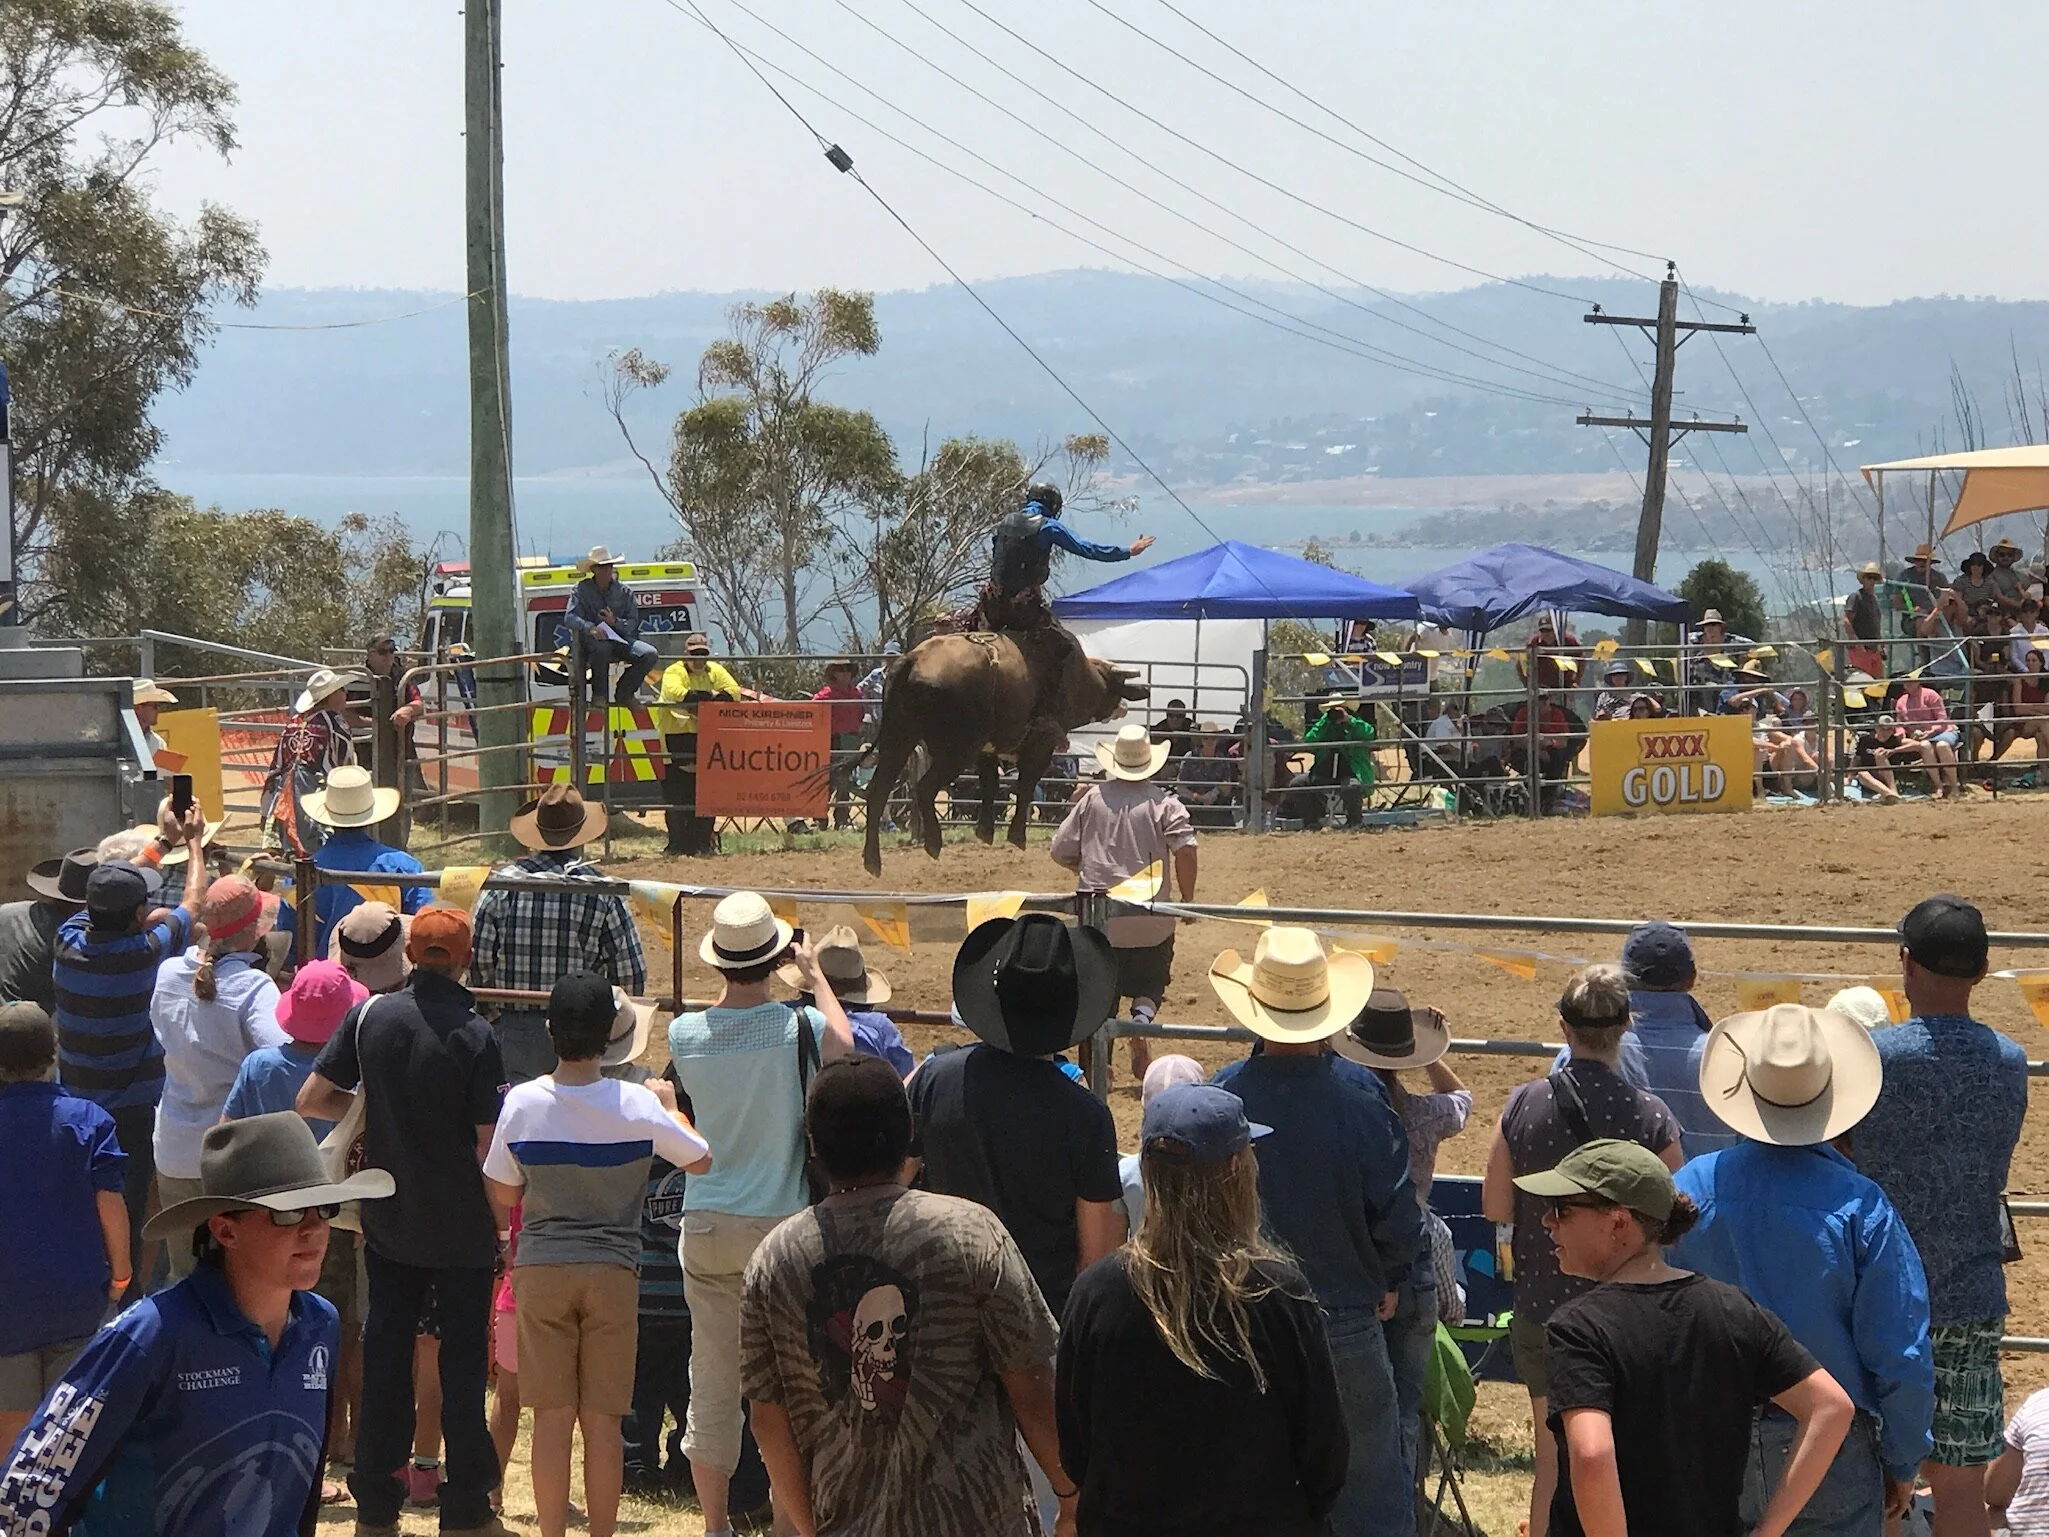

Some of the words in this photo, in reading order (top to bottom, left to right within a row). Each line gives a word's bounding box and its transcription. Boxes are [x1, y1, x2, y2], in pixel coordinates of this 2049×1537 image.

[669, 611, 687, 622] 12
[719, 709, 748, 718] NICK
[752, 710, 814, 719] KIRSHNER
[1645, 735, 1704, 758] XXXX
[706, 741, 819, 771] Auction
[1622, 764, 1726, 807] GOLD
[177, 1366, 241, 1382] STOCKMAN'S
[178, 1375, 241, 1391] CHALLENGE
